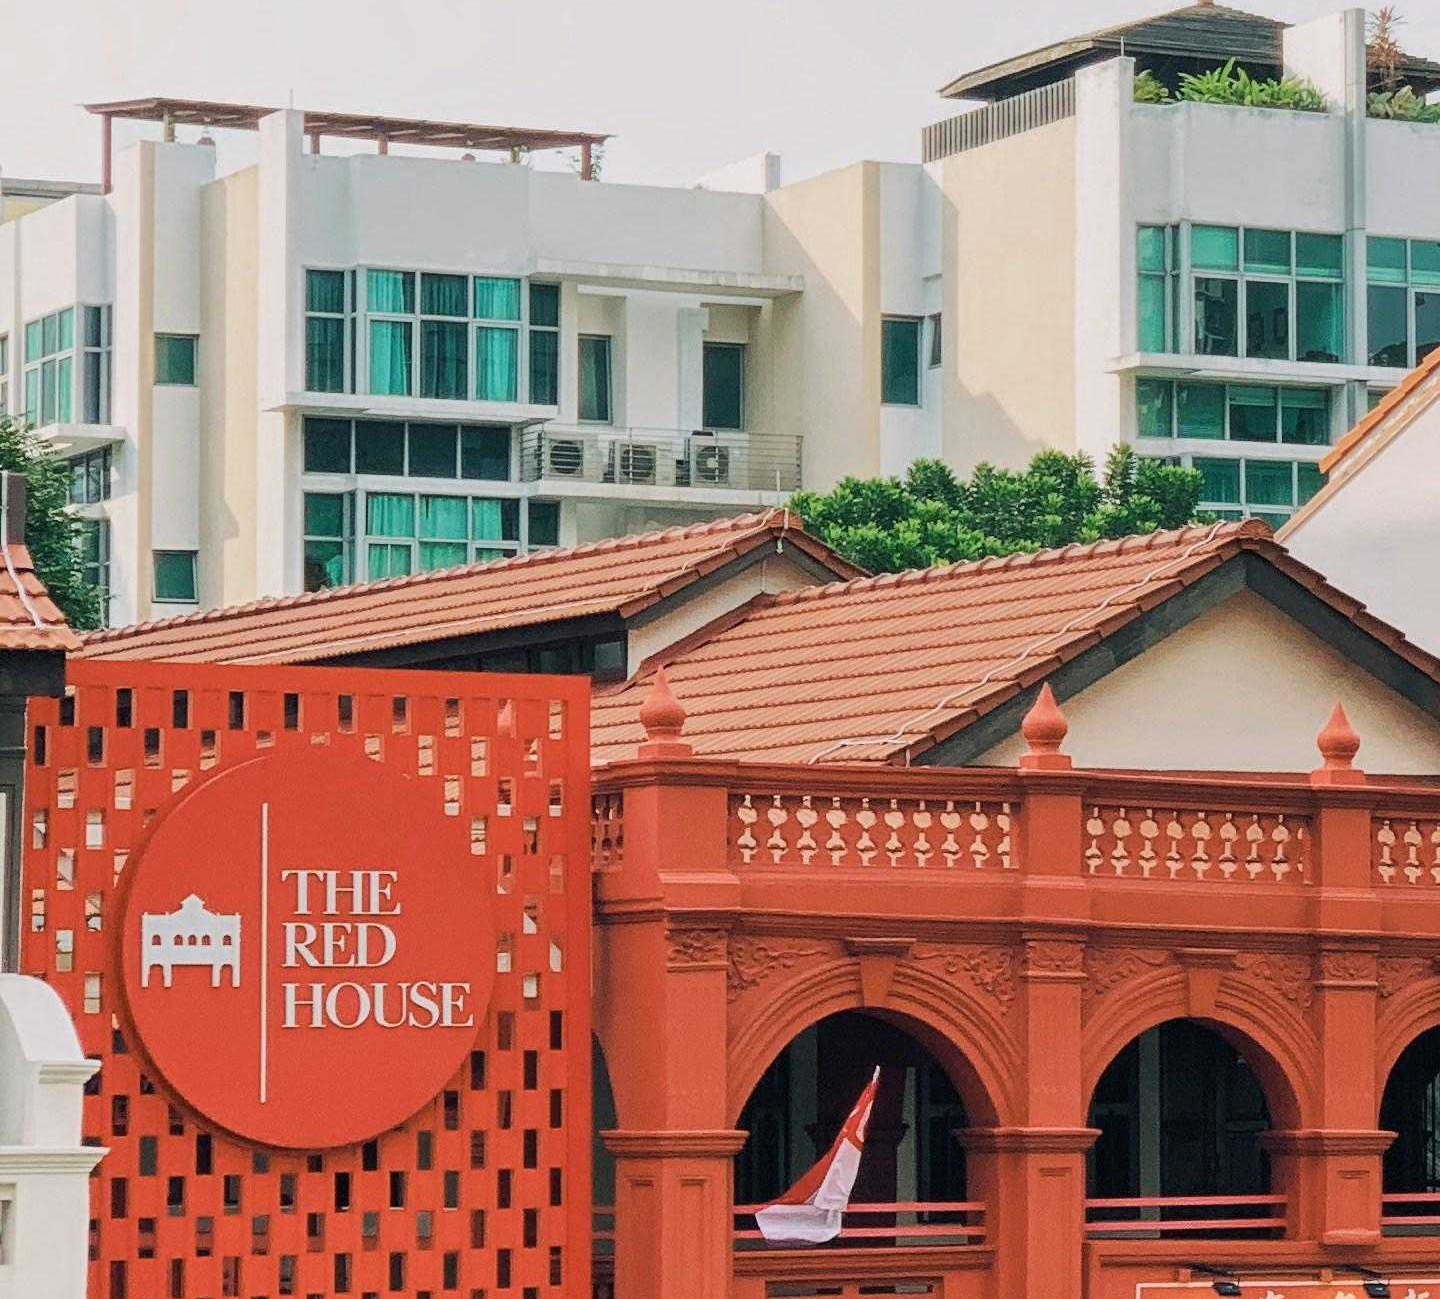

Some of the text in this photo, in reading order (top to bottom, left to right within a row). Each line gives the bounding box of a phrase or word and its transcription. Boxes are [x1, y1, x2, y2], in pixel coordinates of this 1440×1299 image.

[280, 869, 401, 915] THE
[280, 921, 397, 968] RED
[280, 980, 474, 1029] HOUSE
